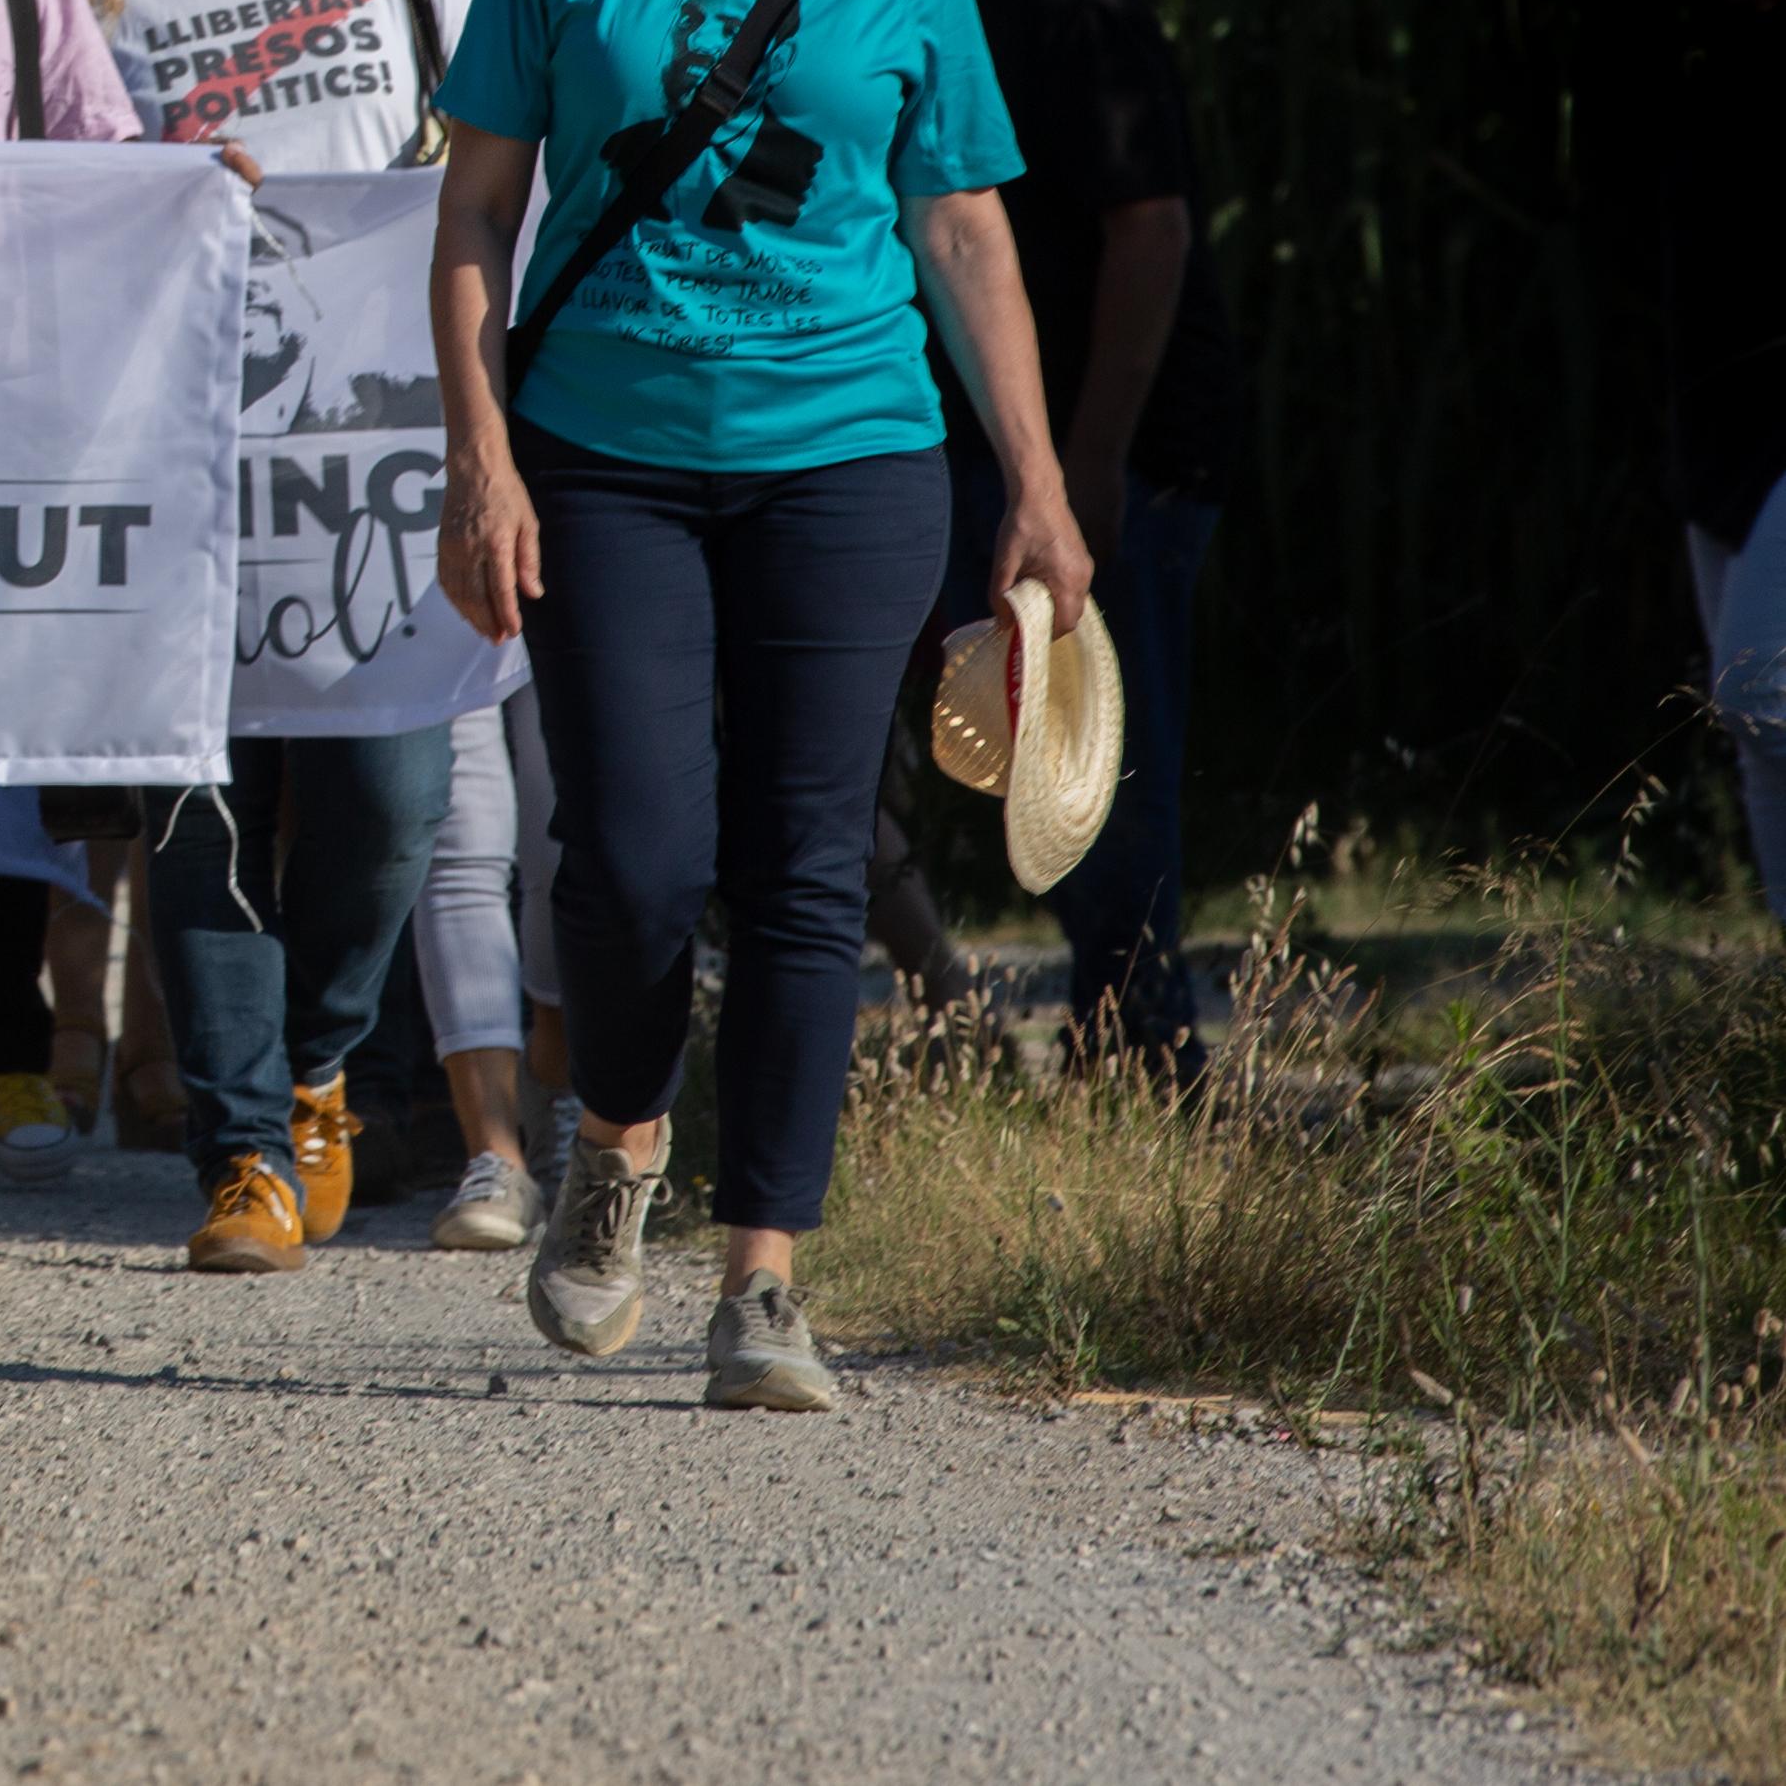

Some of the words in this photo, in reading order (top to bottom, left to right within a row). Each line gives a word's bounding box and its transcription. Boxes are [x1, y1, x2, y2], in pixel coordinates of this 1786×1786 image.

[153, 18, 383, 93] PRESOS
[161, 60, 395, 135] POLÍTICS!
[705, 247, 736, 265] DE
[581, 286, 652, 316] LLAVOR
[660, 300, 689, 322] DE
[699, 302, 773, 328] TOTES
[781, 305, 823, 334] LES
[737, 277, 814, 306] TAMBÉ
